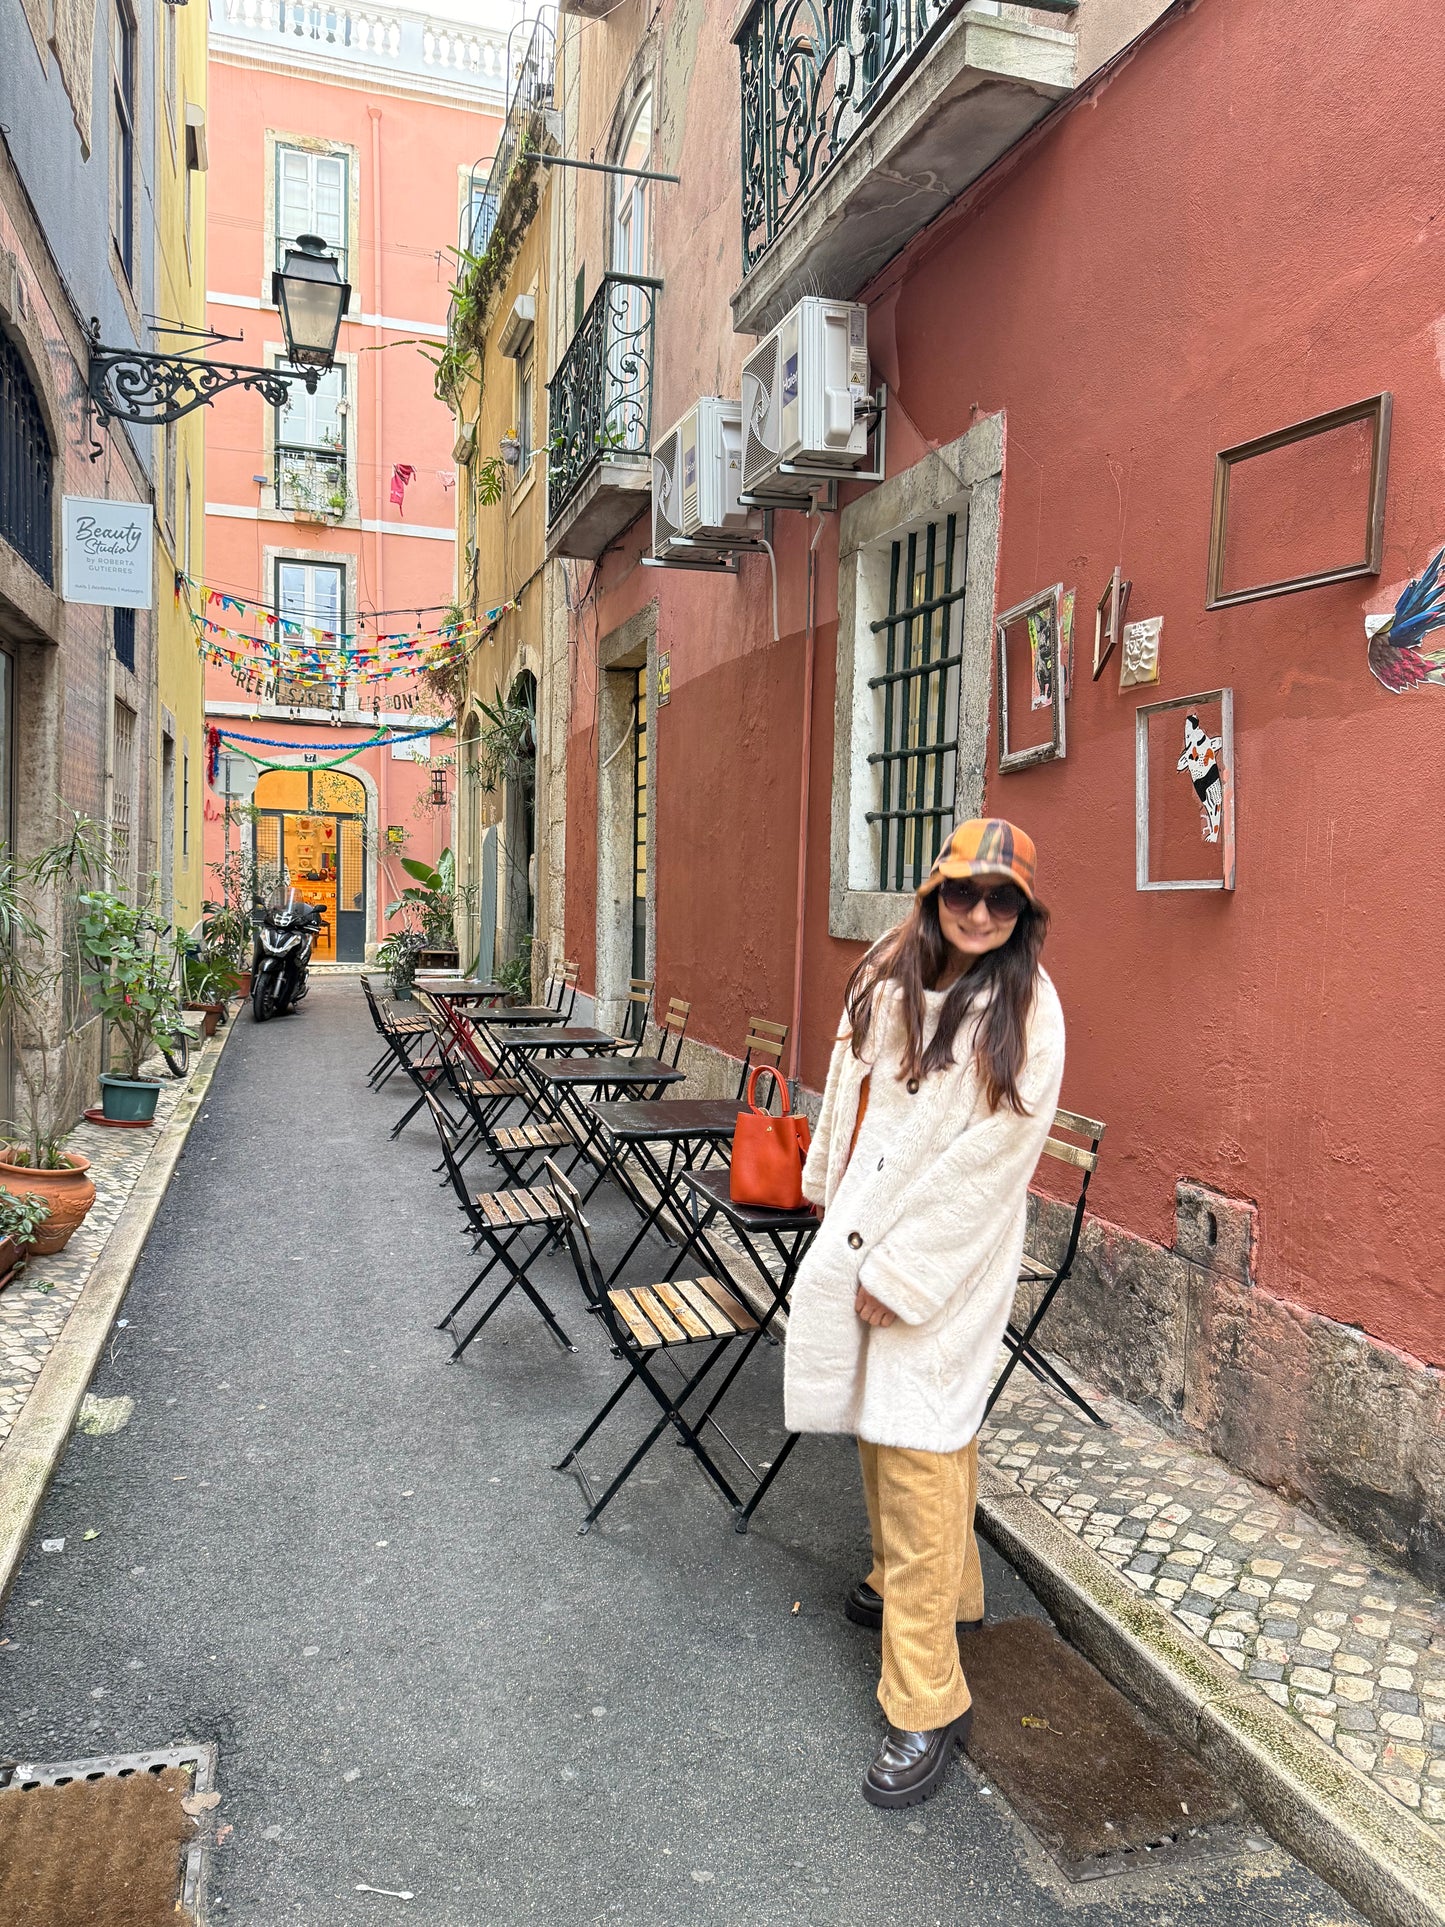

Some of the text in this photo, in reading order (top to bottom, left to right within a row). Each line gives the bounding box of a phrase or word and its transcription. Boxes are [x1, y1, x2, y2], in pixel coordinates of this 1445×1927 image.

[75, 516, 142, 553] Beauty
[83, 538, 127, 555] Studio
[86, 556, 135, 567] by ROBERTA
[88, 565, 133, 575] GUTIERRES
[306, 754, 315, 762] 27
